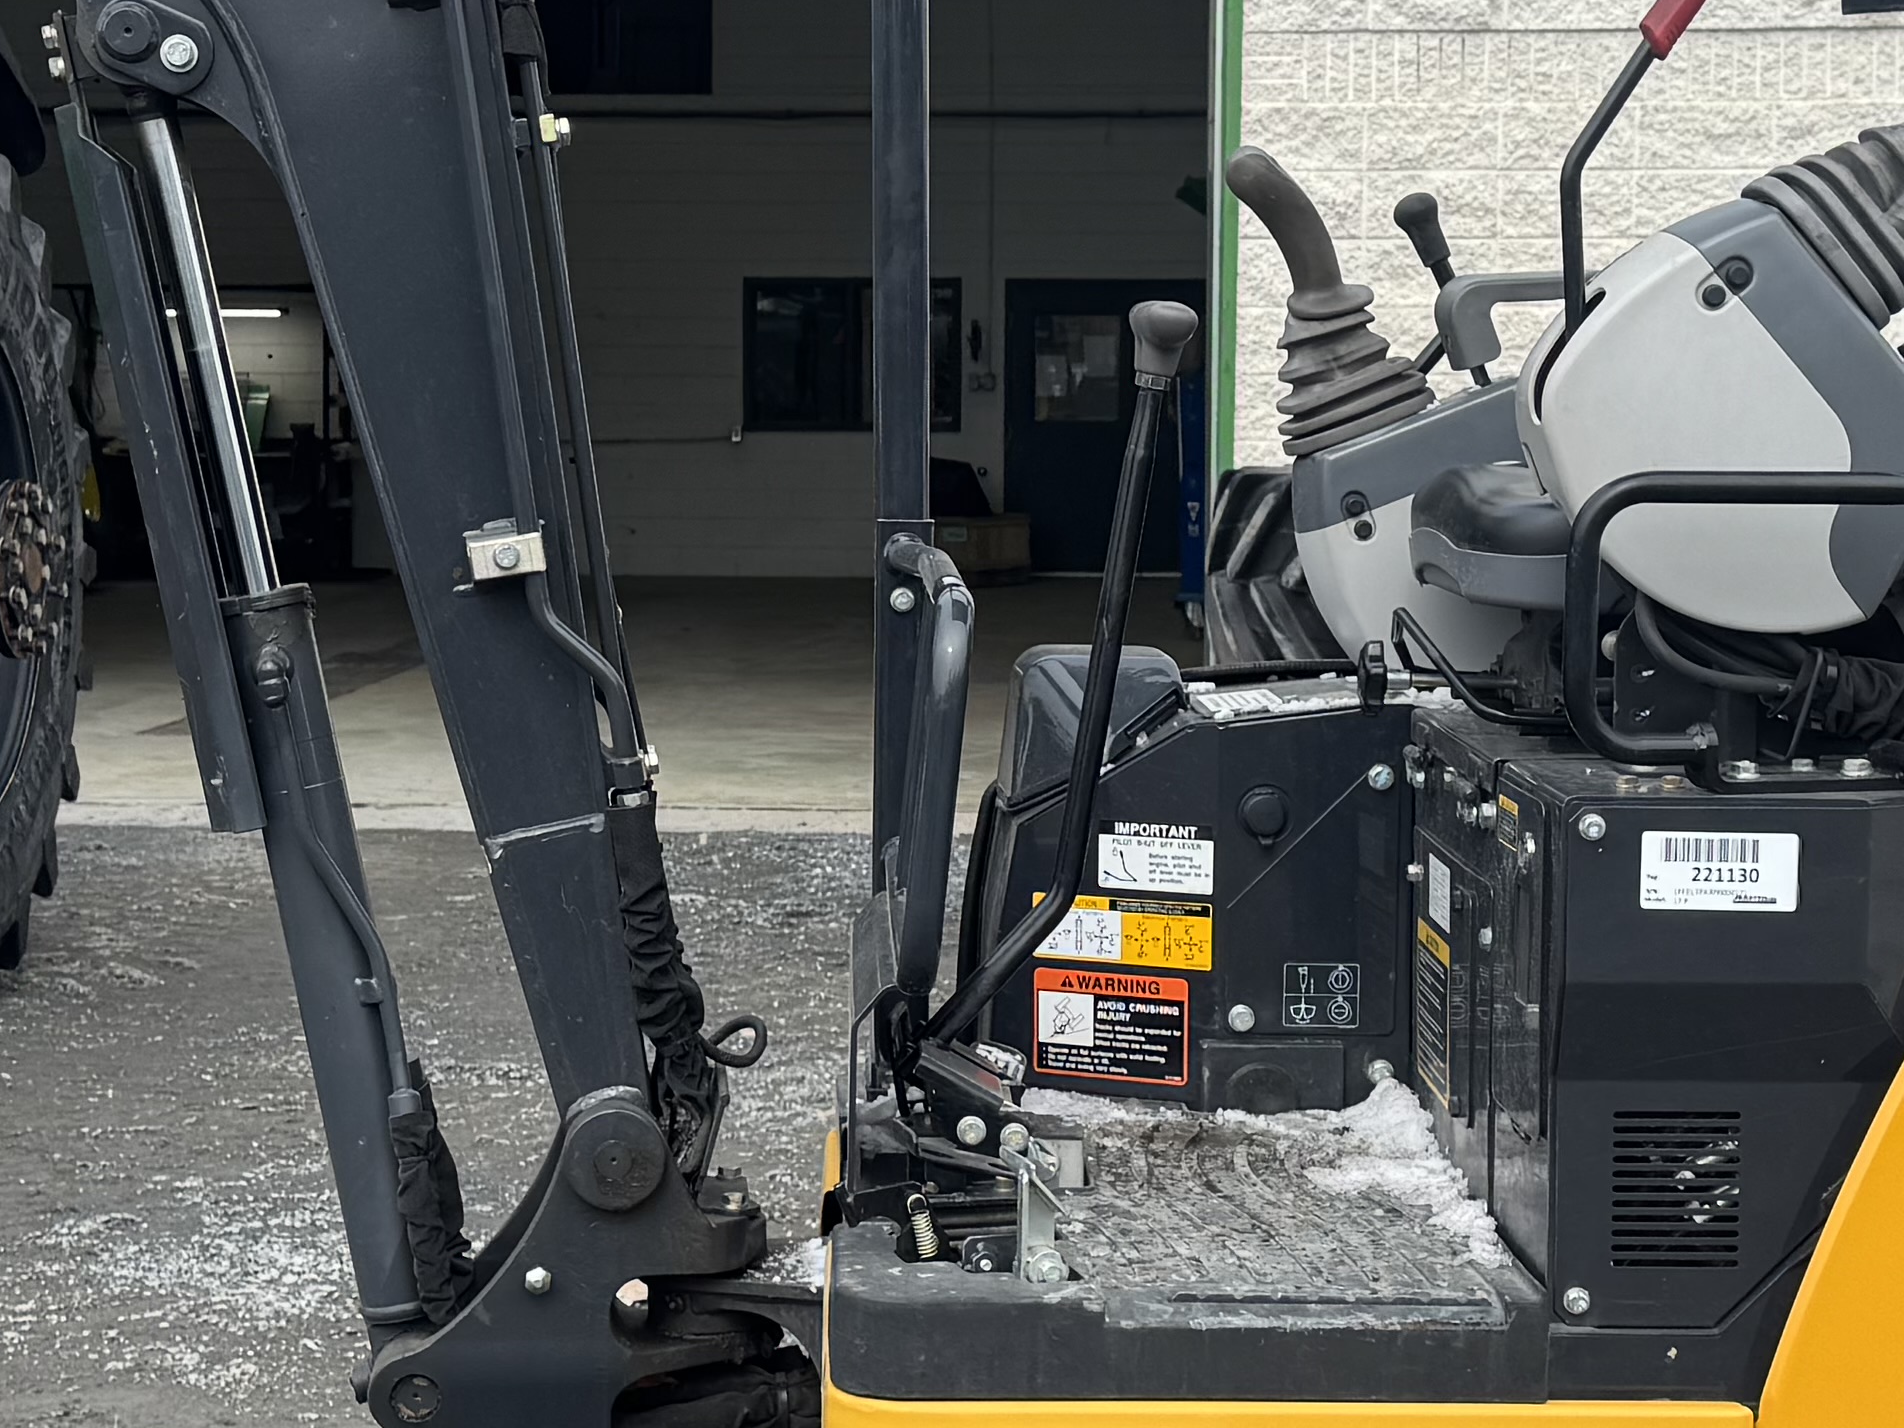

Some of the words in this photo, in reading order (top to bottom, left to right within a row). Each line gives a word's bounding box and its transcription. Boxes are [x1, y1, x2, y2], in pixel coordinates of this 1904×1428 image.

[1114, 822, 1198, 839] IMPORTANT
[1691, 867, 1760, 883] 221130
[1076, 975, 1160, 995] WARNING
